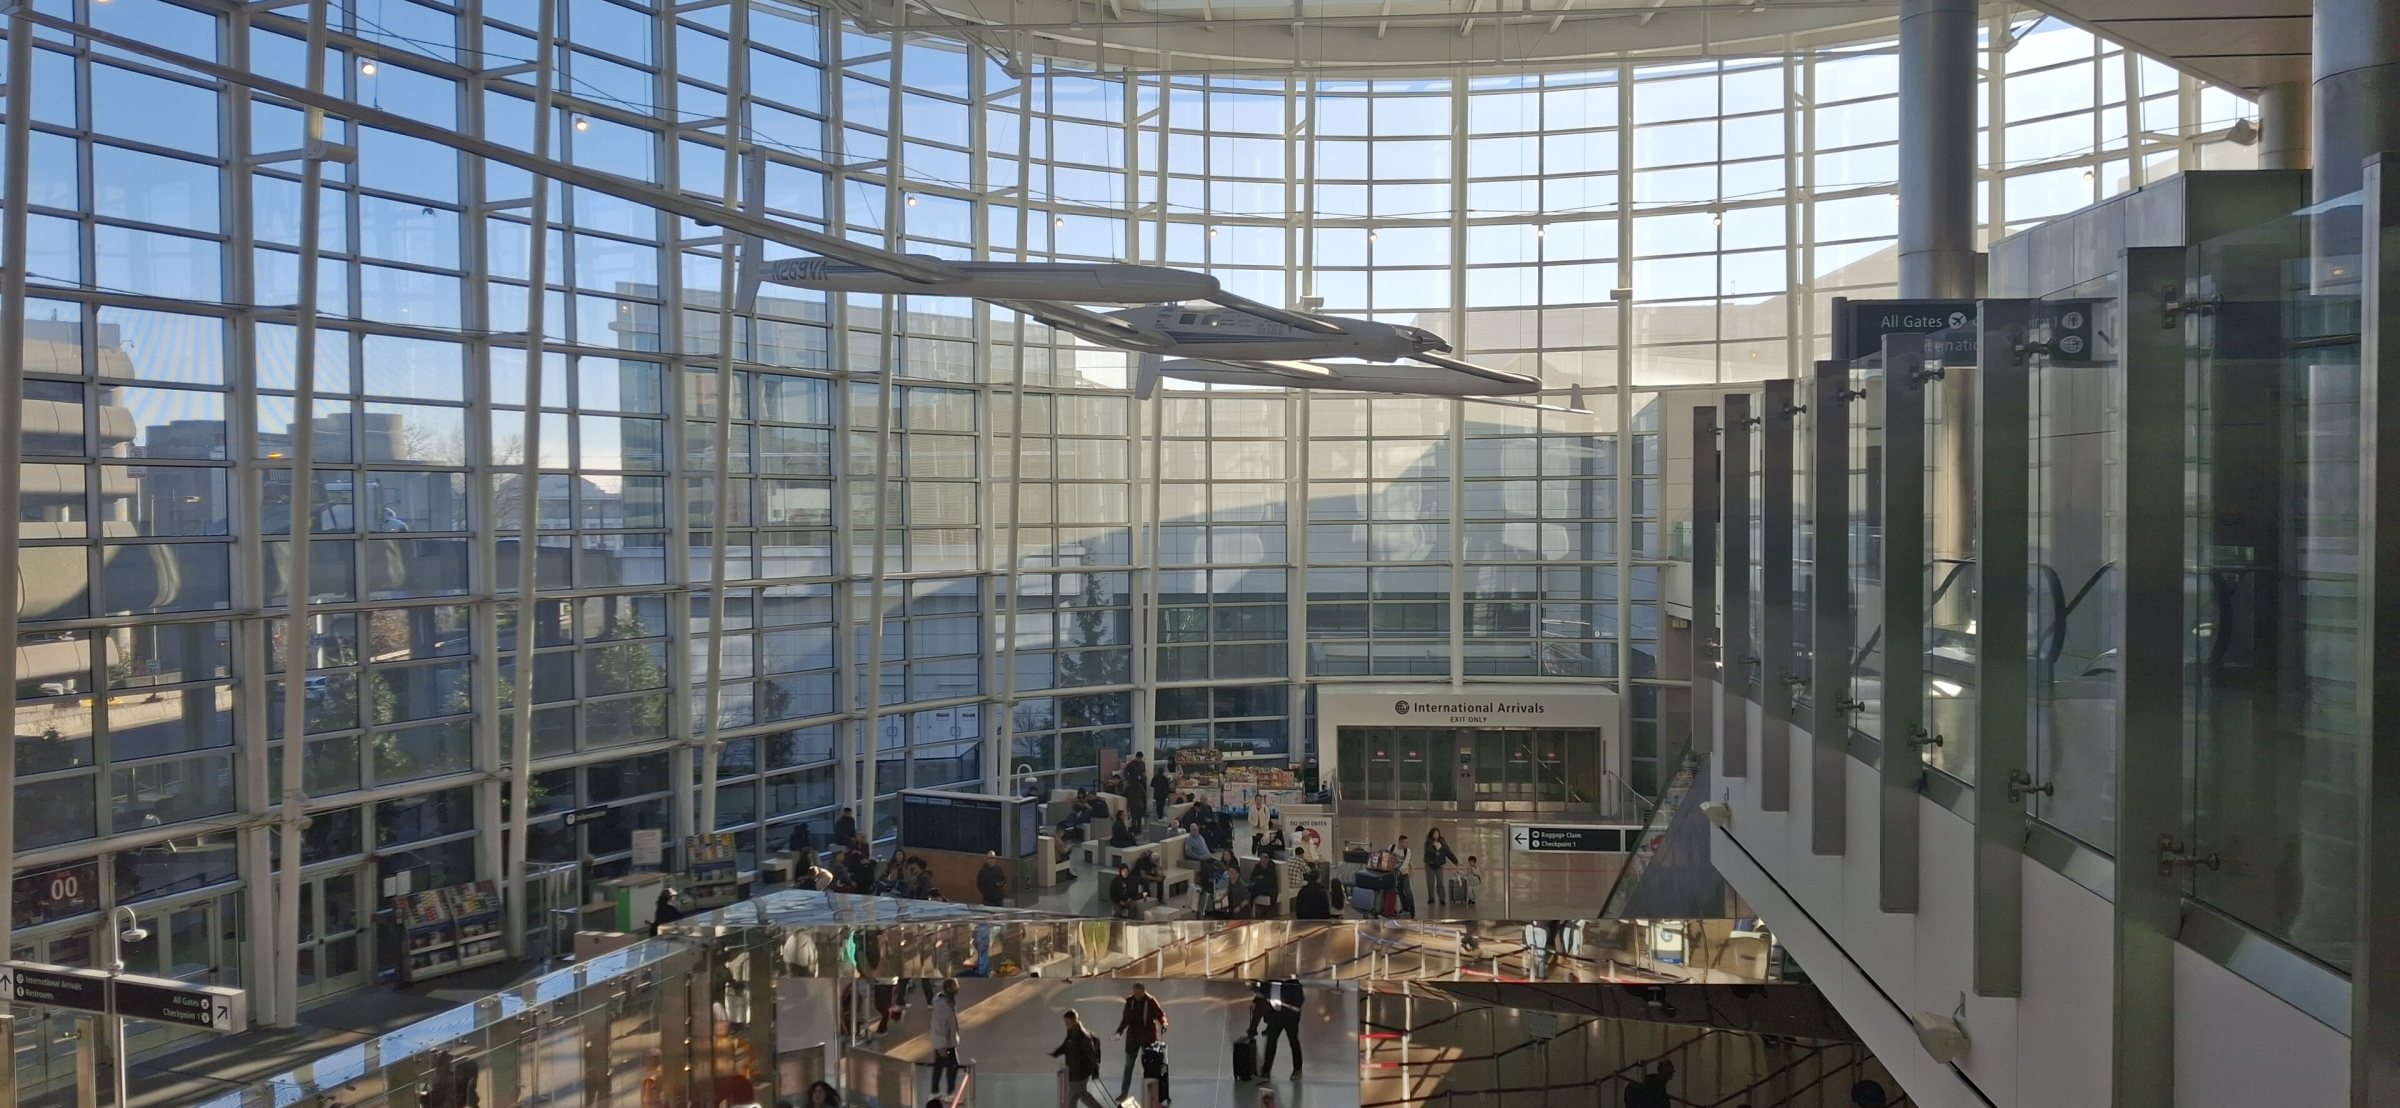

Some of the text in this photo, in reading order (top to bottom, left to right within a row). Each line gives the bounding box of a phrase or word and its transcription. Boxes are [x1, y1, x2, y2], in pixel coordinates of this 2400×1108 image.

[1881, 314, 1943, 328] All Gates
[1414, 702, 1545, 714] International Arrivals
[1541, 840, 1572, 848] Checkpoint
[51, 876, 78, 901] 00
[25, 976, 82, 991] International Arrivals
[25, 988, 54, 999] Restrooms
[172, 995, 200, 1007] All Gates
[163, 1008, 196, 1019] Checkpoint
